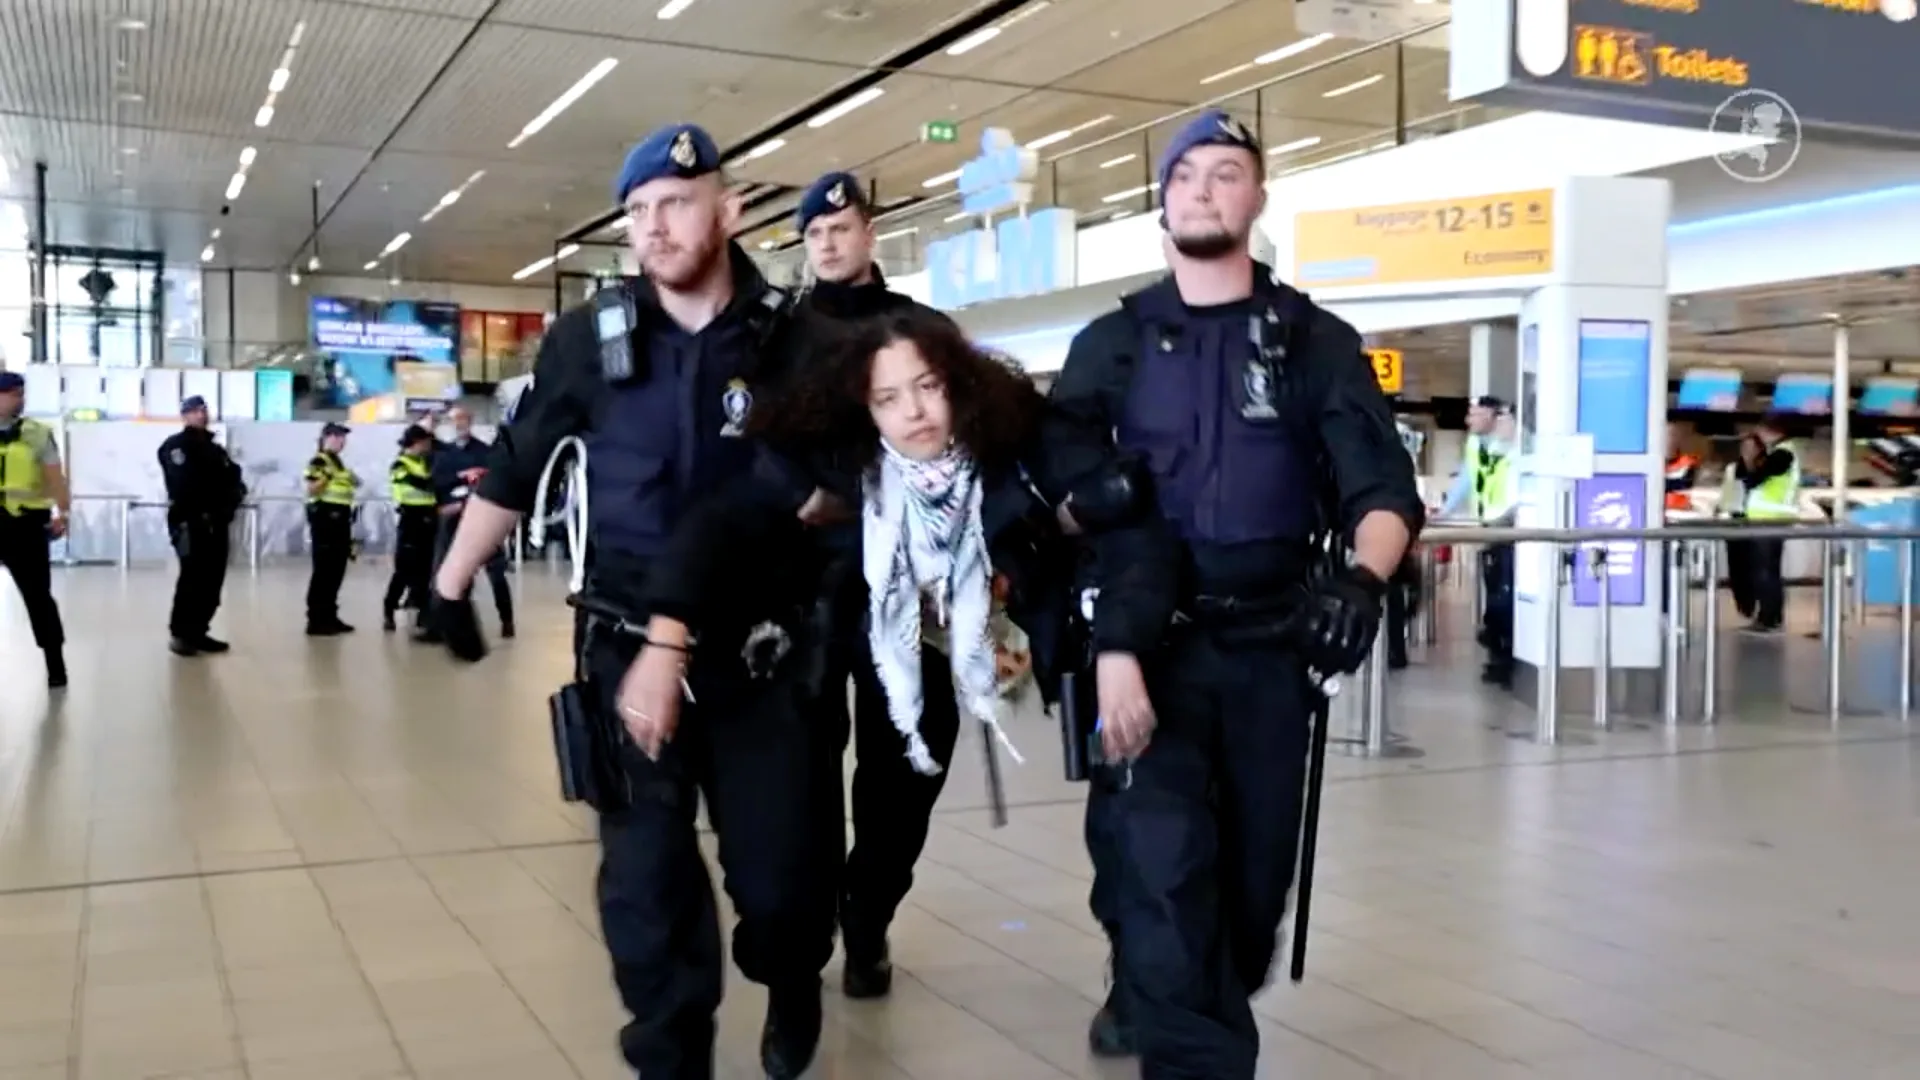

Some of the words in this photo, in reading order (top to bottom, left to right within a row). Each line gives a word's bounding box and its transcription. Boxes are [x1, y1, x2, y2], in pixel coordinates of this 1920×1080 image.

[1655, 45, 1749, 86] Toilets
[1435, 201, 1514, 233] 12-15
[928, 207, 1064, 310] KLM
